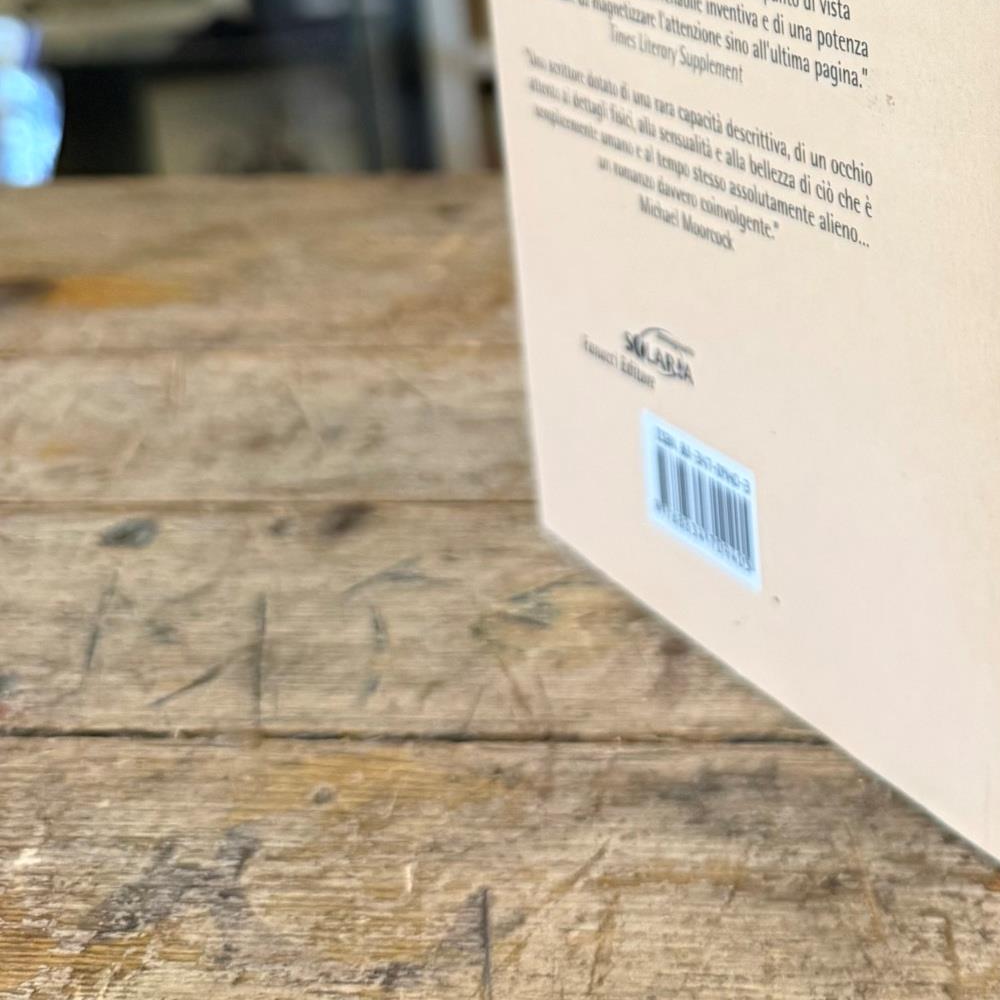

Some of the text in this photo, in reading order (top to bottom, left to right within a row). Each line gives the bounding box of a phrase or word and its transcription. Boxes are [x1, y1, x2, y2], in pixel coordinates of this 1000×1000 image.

[609, 23, 636, 50] Times
[679, 45, 743, 83] Supplement
[658, 10, 722, 47] l'attenzione
[725, 32, 749, 55] sino
[752, 39, 810, 73] all'ultima
[814, 60, 868, 88] pagina."
[762, 15, 769, 31] e
[773, 14, 784, 35] di
[789, 21, 812, 42] una
[817, 29, 869, 58] potenza
[621, 82, 630, 100] di
[633, 91, 651, 109] una
[654, 97, 675, 117] rara
[678, 106, 723, 135] capacità
[726, 118, 791, 161] descrittiva,
[794, 141, 806, 164] di
[810, 151, 827, 170] un
[831, 158, 872, 186] occhio
[659, 128, 713, 159] sensualità
[715, 149, 722, 162] e
[725, 147, 746, 172] alla
[749, 154, 795, 190] bellezza
[800, 173, 811, 195] di
[816, 180, 834, 204] ciò
[838, 188, 861, 214] che
[864, 195, 872, 218] è
[657, 150, 690, 178] tempo
[692, 165, 726, 191] stesso
[729, 182, 816, 227] assolutamente
[819, 212, 870, 248] alieno...
[700, 195, 780, 240] coinvolgente."
